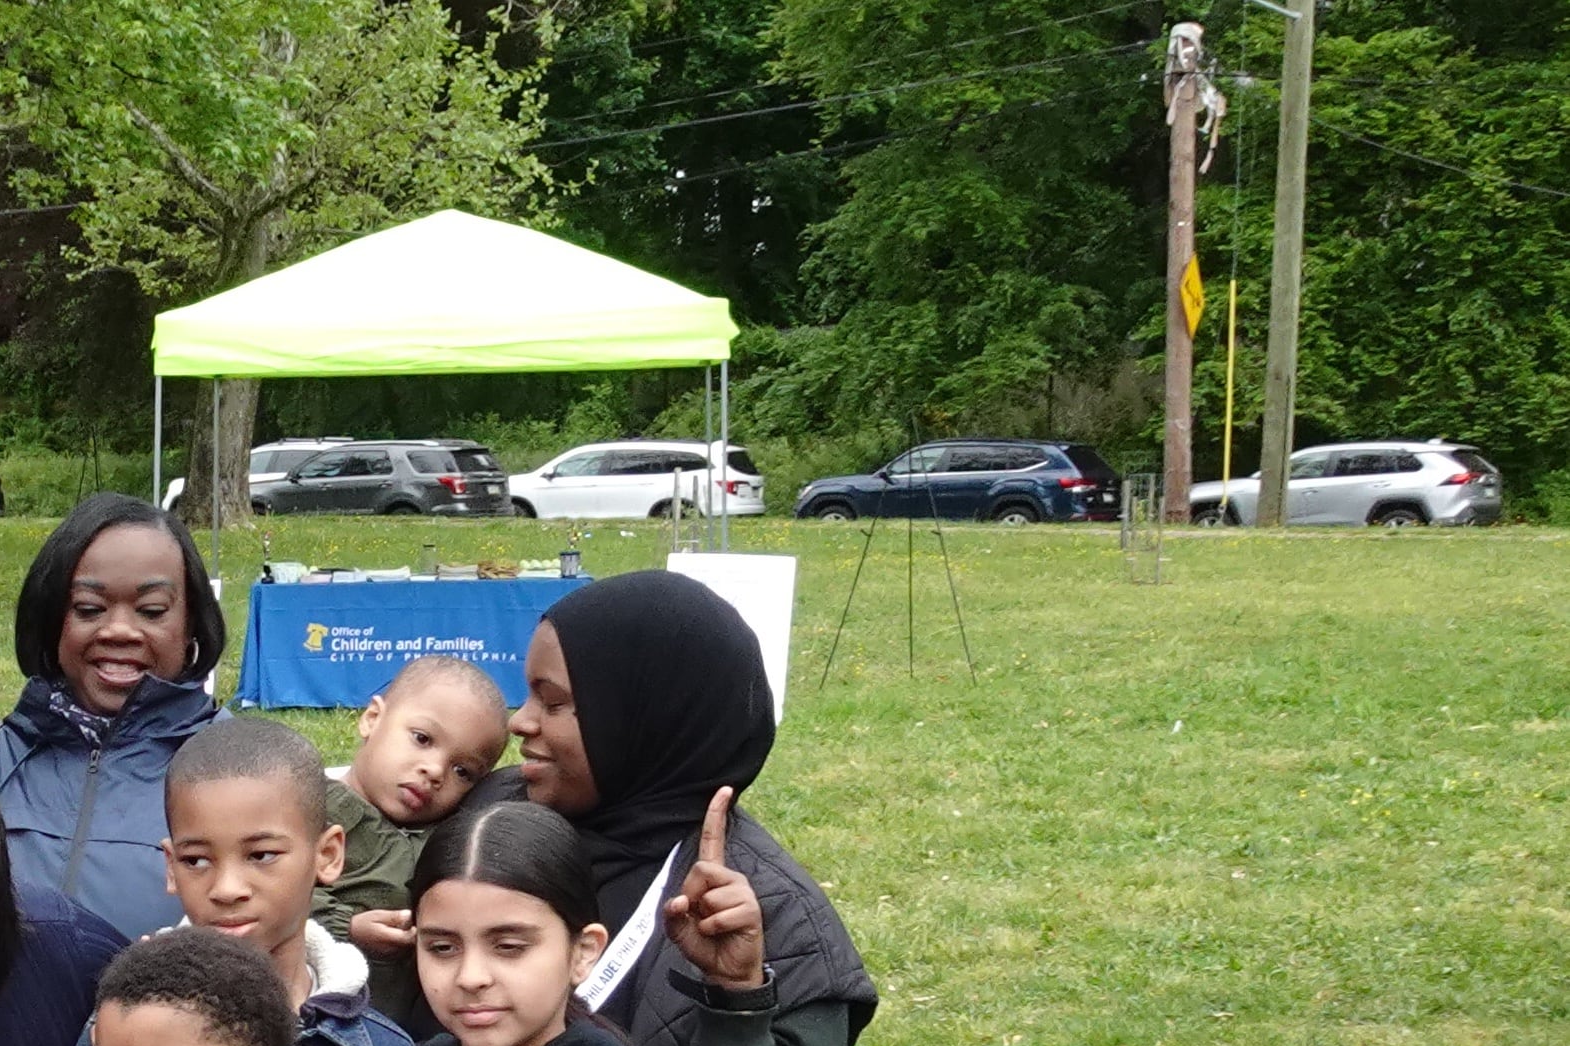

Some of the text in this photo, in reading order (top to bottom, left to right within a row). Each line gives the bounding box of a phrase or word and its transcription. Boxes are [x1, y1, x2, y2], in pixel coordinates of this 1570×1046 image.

[331, 626, 375, 637] Office of
[331, 636, 485, 651] Children and Families
[330, 652, 517, 662] CITY OF PHDELPHIA
